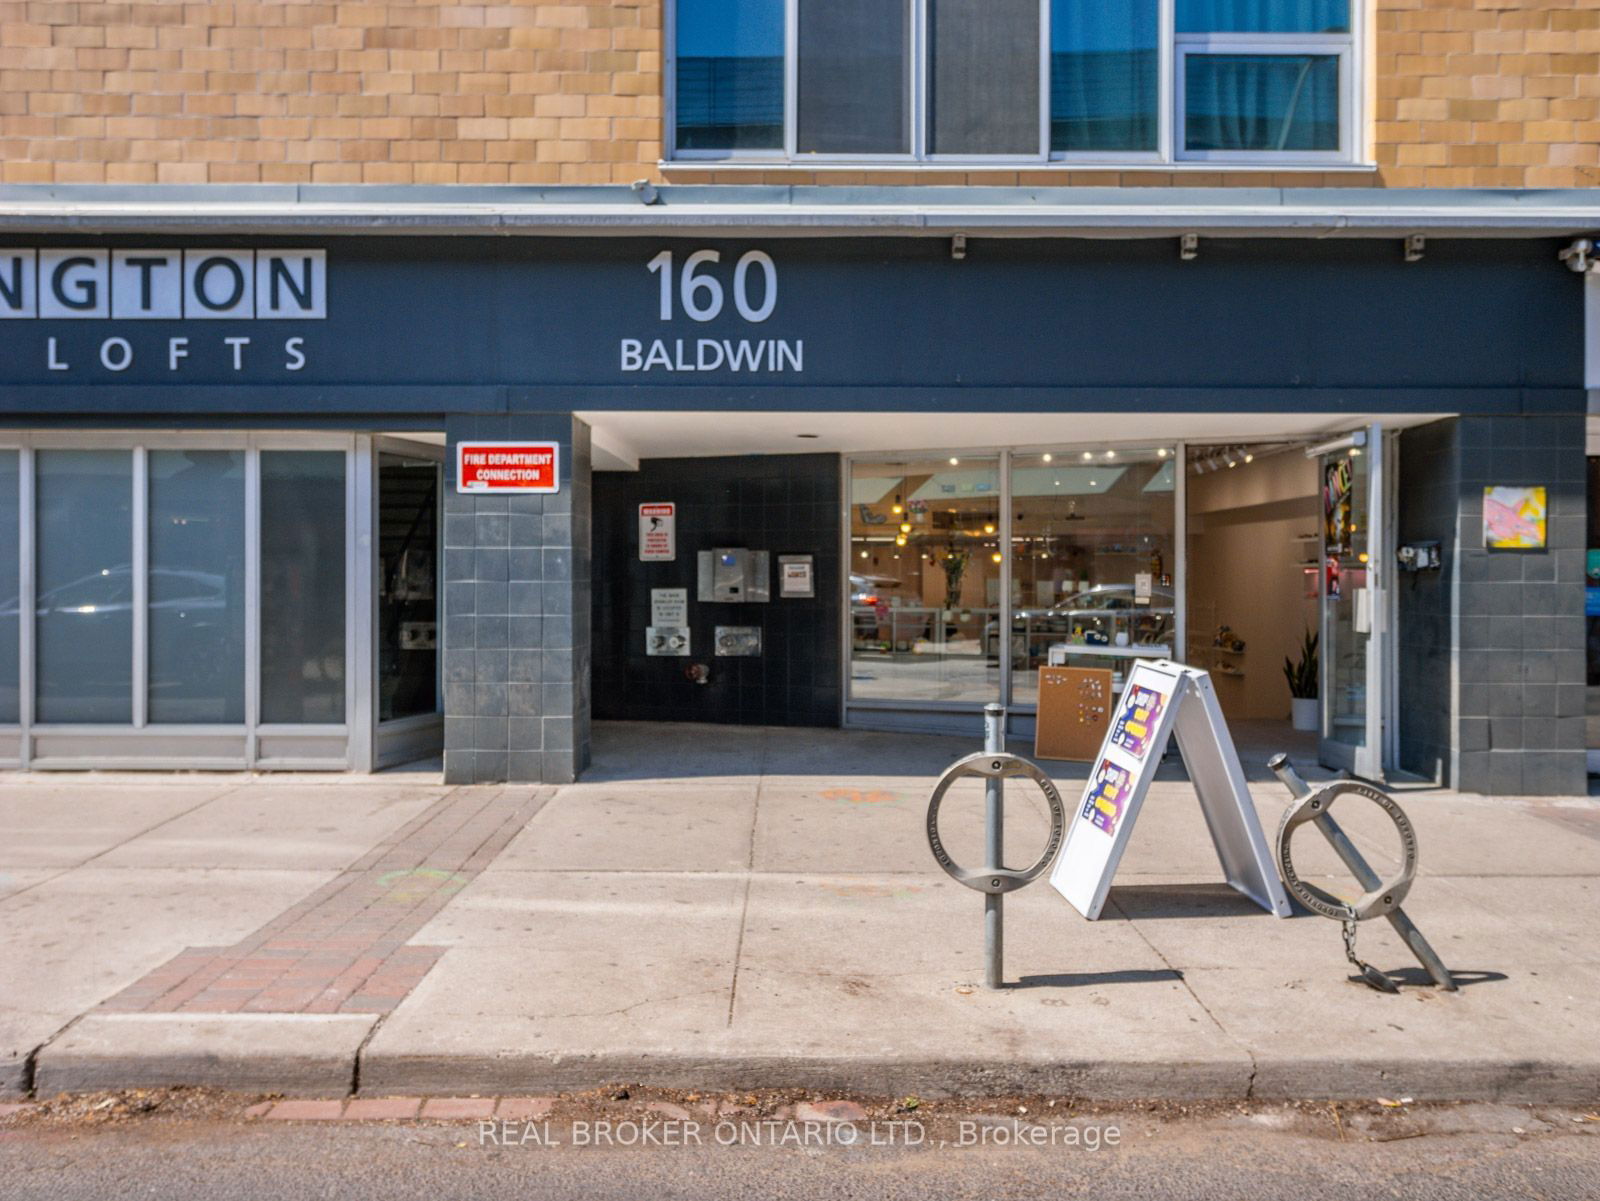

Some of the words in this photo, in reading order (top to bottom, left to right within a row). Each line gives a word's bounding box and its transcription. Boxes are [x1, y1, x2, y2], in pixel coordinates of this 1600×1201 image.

[647, 249, 777, 322] 160
[48, 337, 306, 371] LOFTS
[621, 339, 803, 372] BALDWIN
[463, 454, 486, 465] FIRE
[488, 454, 552, 465] DEPARTMENT
[476, 469, 540, 480] CONNECTION
